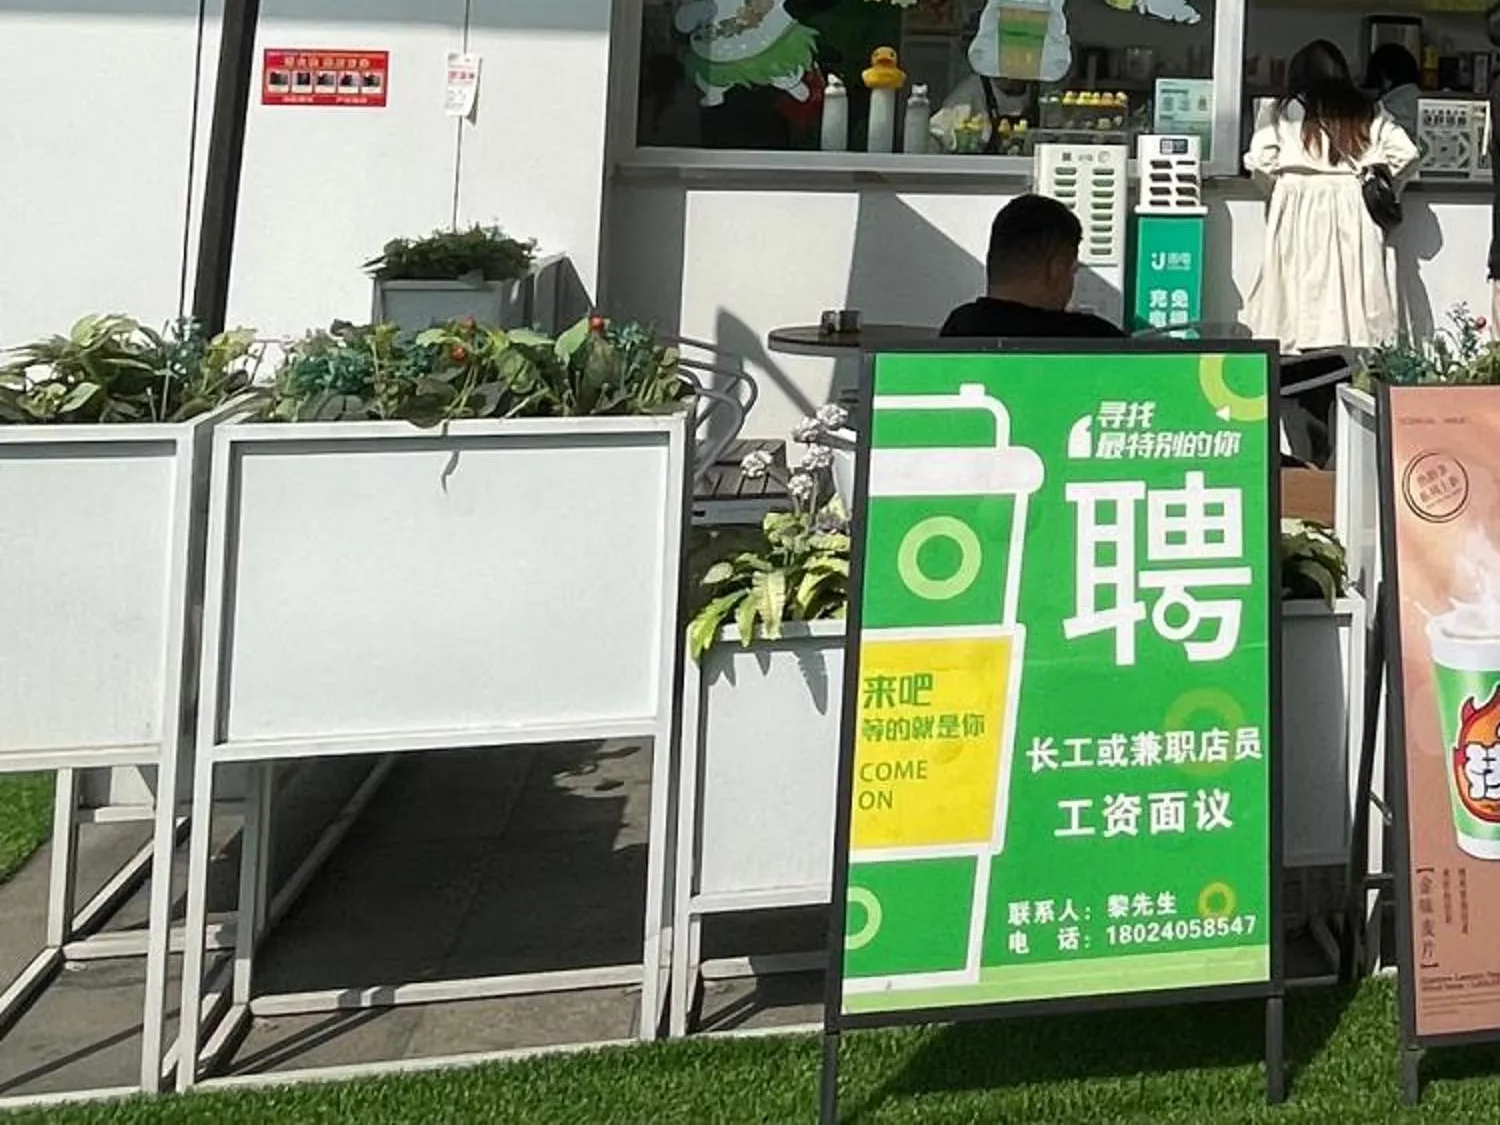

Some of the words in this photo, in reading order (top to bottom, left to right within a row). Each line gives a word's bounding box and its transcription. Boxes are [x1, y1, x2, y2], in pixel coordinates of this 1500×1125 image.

[1096, 400, 1156, 428] 寻找
[1095, 430, 1241, 460] 最特别的你
[1063, 470, 1253, 666] 聘
[863, 672, 934, 709] 来吧
[1026, 727, 1263, 773] 长工或兼职店员
[860, 759, 928, 782] COME
[858, 789, 894, 811] ON
[1054, 788, 1234, 838] 工资面议
